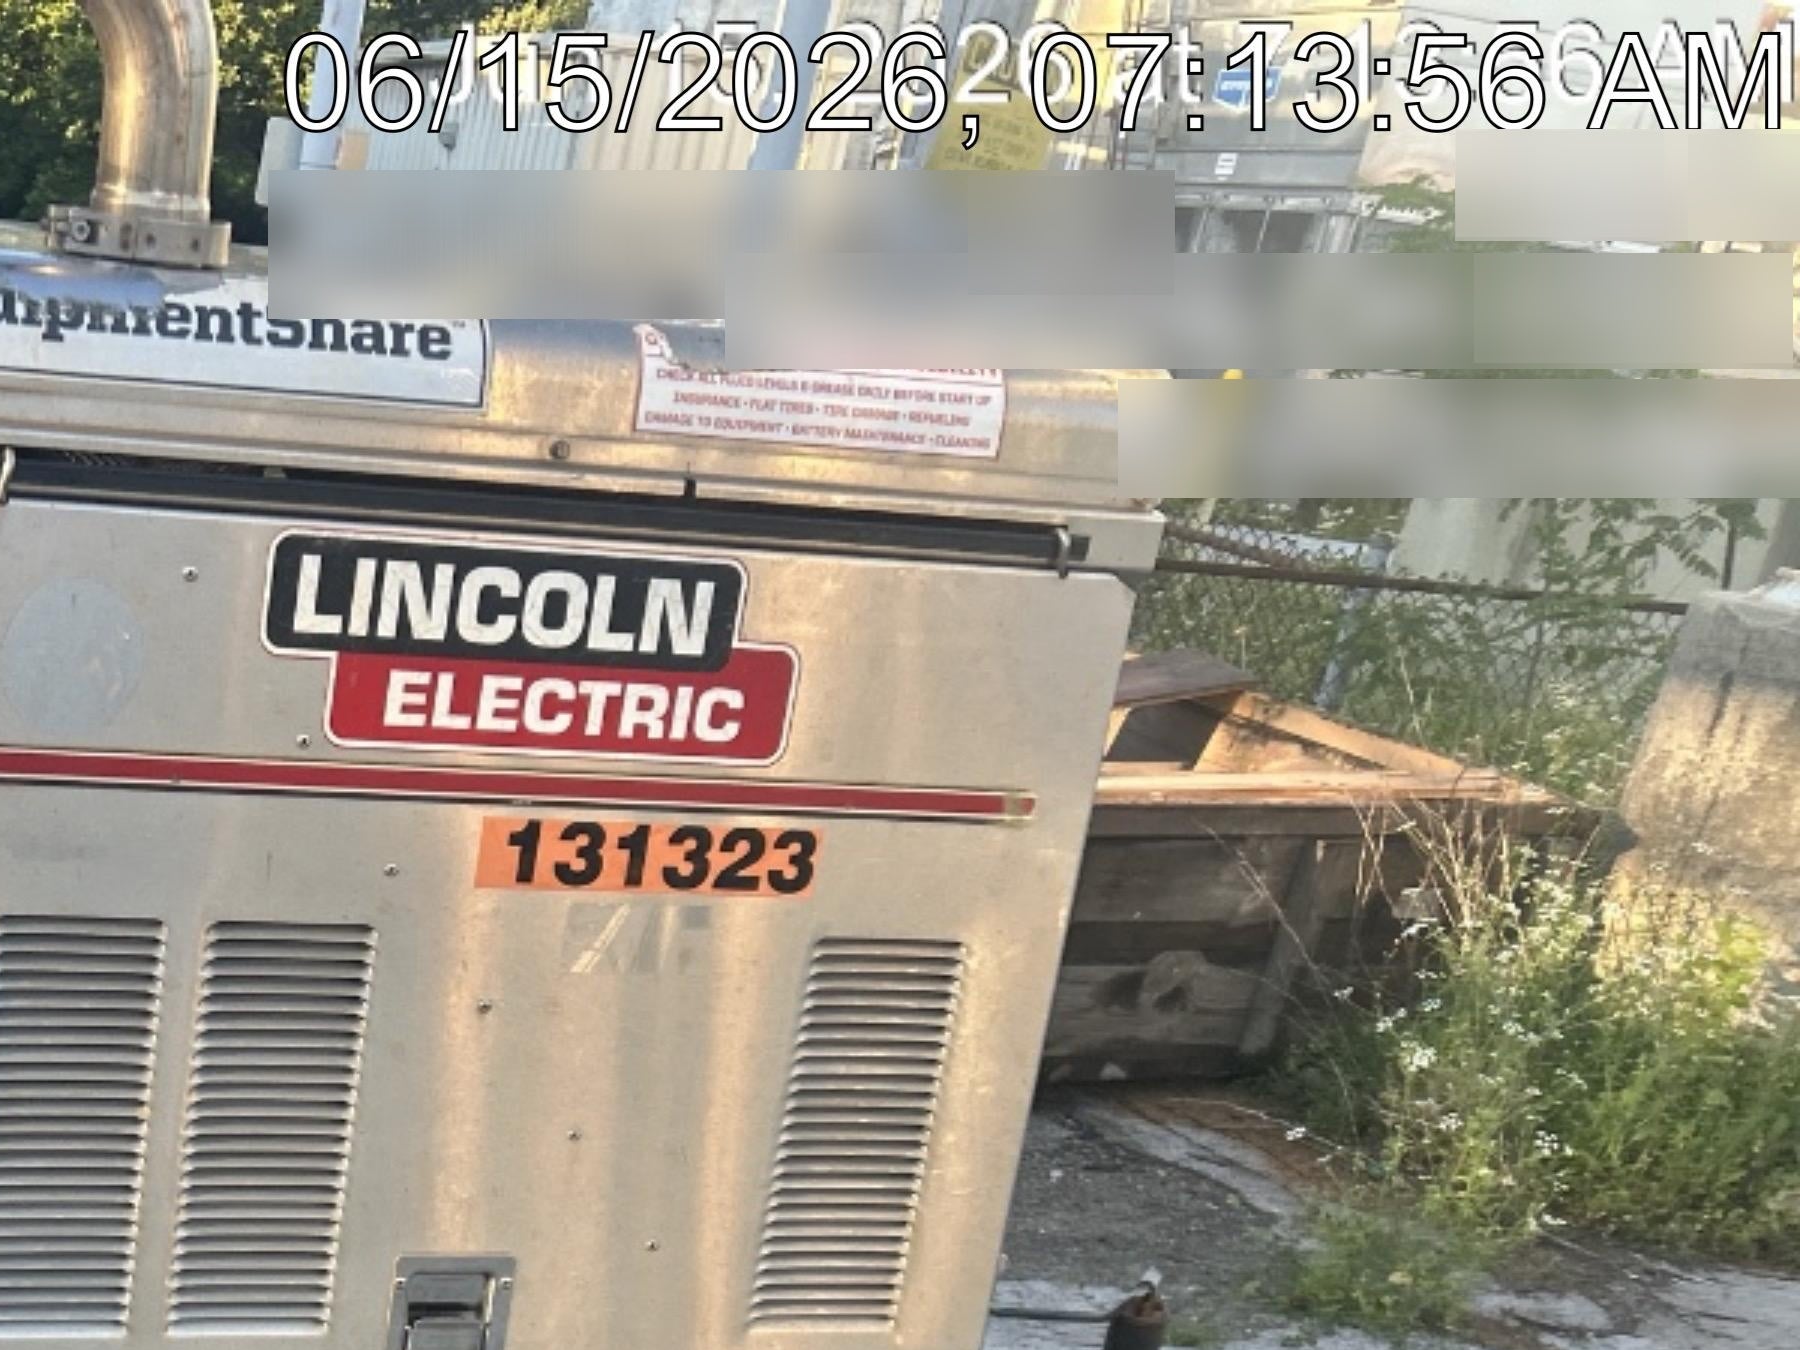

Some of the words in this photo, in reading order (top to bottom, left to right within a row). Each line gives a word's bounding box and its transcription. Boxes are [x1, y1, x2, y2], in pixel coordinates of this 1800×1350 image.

[292, 553, 717, 656] LINCOLN
[383, 668, 746, 743] ELECTRIC
[507, 818, 817, 893] 131323
